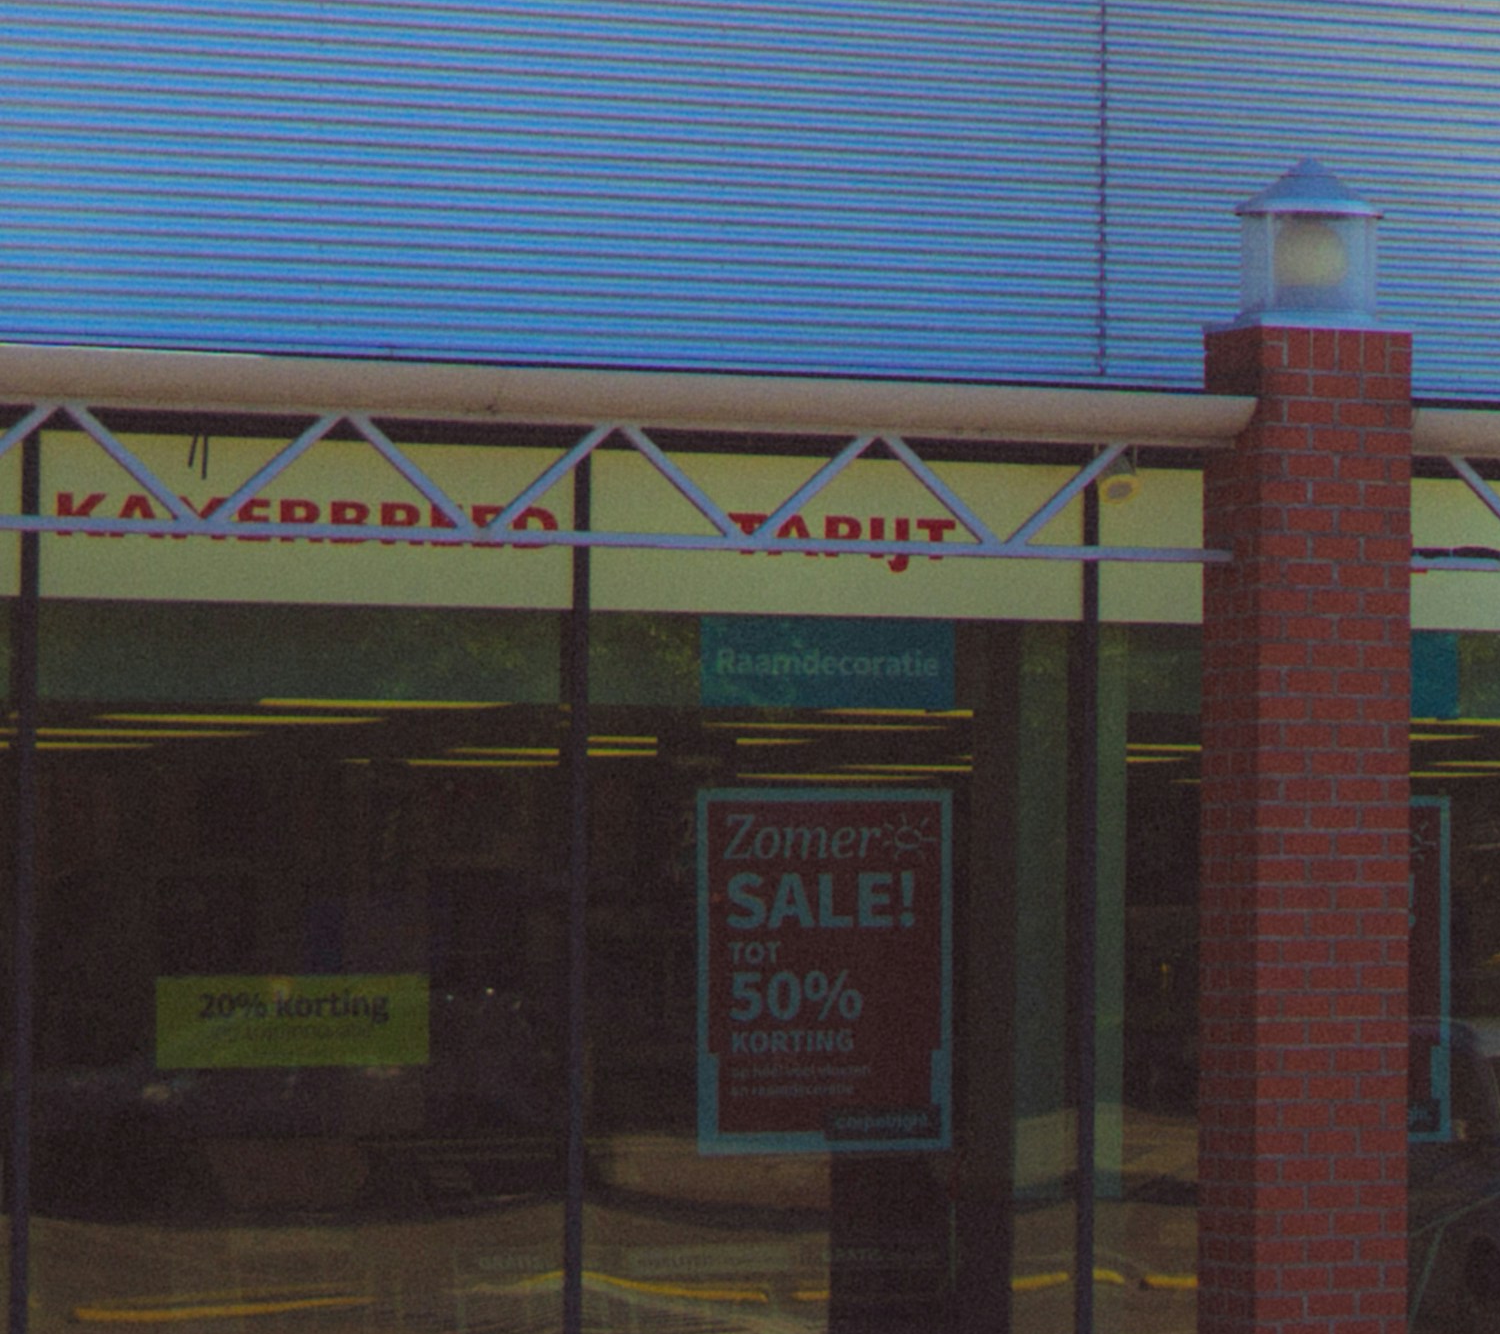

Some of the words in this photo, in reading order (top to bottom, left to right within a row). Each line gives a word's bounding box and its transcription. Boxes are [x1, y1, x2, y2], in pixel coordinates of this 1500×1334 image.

[715, 647, 940, 676] Raamdecoratie
[724, 813, 880, 860] Zomer
[726, 871, 915, 930] SALE!
[728, 941, 781, 965] TOT
[199, 993, 267, 1019] 20%
[275, 989, 389, 1024] korting
[730, 969, 862, 1022] 50%
[731, 1030, 854, 1053] KORTING
